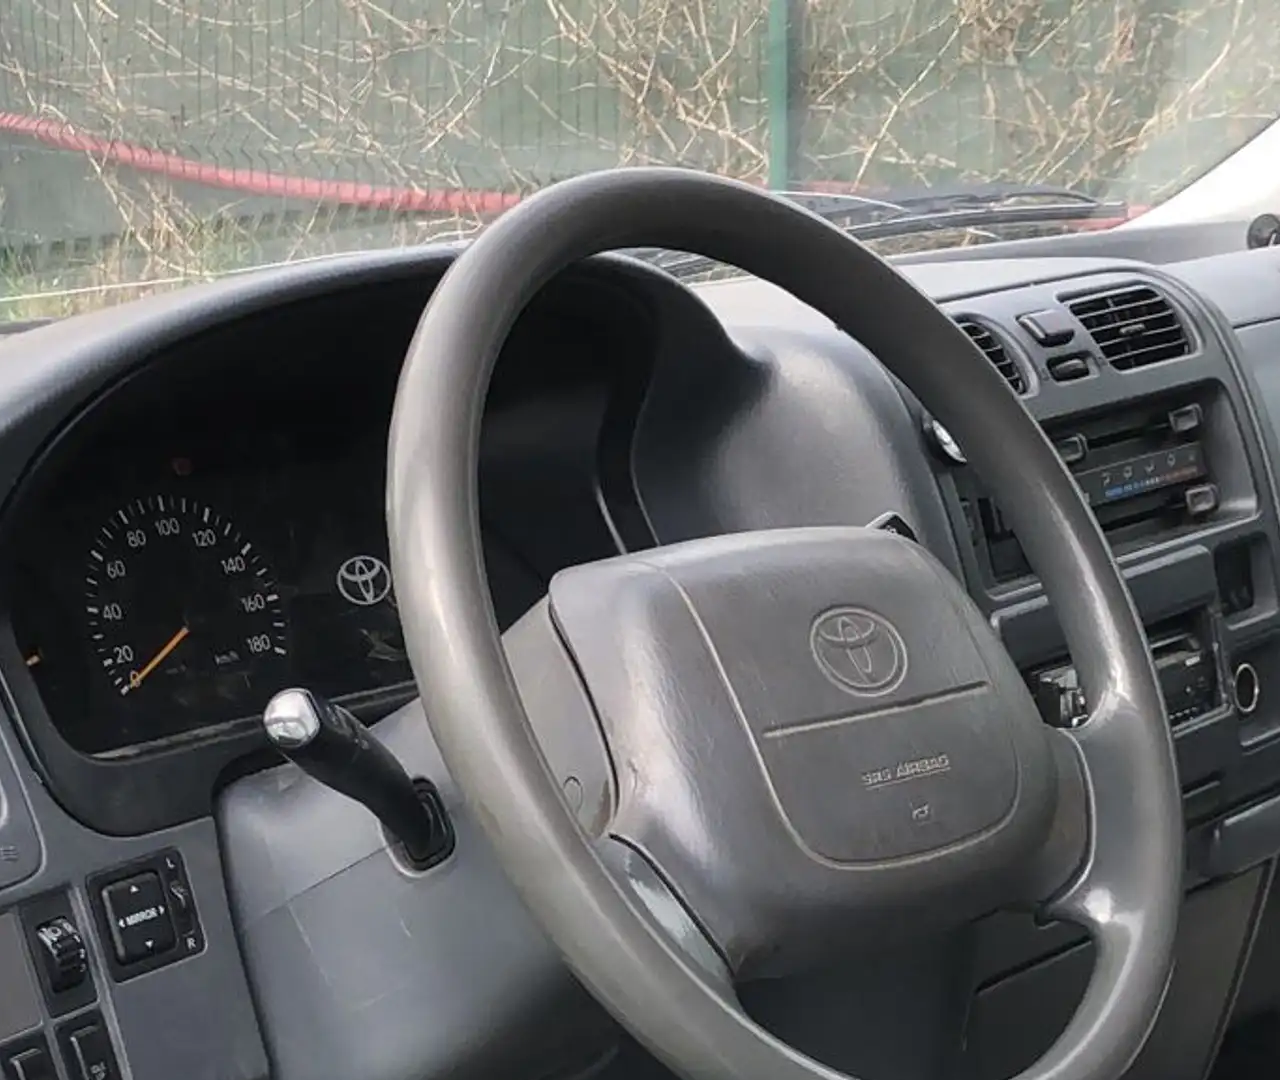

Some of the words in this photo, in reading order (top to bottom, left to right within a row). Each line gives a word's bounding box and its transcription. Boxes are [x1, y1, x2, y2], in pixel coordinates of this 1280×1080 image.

[155, 517, 180, 536] 100
[126, 529, 146, 548] 80
[192, 529, 216, 547] 120
[106, 560, 125, 579] 60
[221, 556, 245, 574] 140
[103, 603, 121, 620] 40
[241, 593, 265, 612] 160
[246, 634, 271, 652] 180
[114, 645, 133, 664] 20
[896, 754, 949, 778] AIRBAG
[186, 937, 196, 950] R
